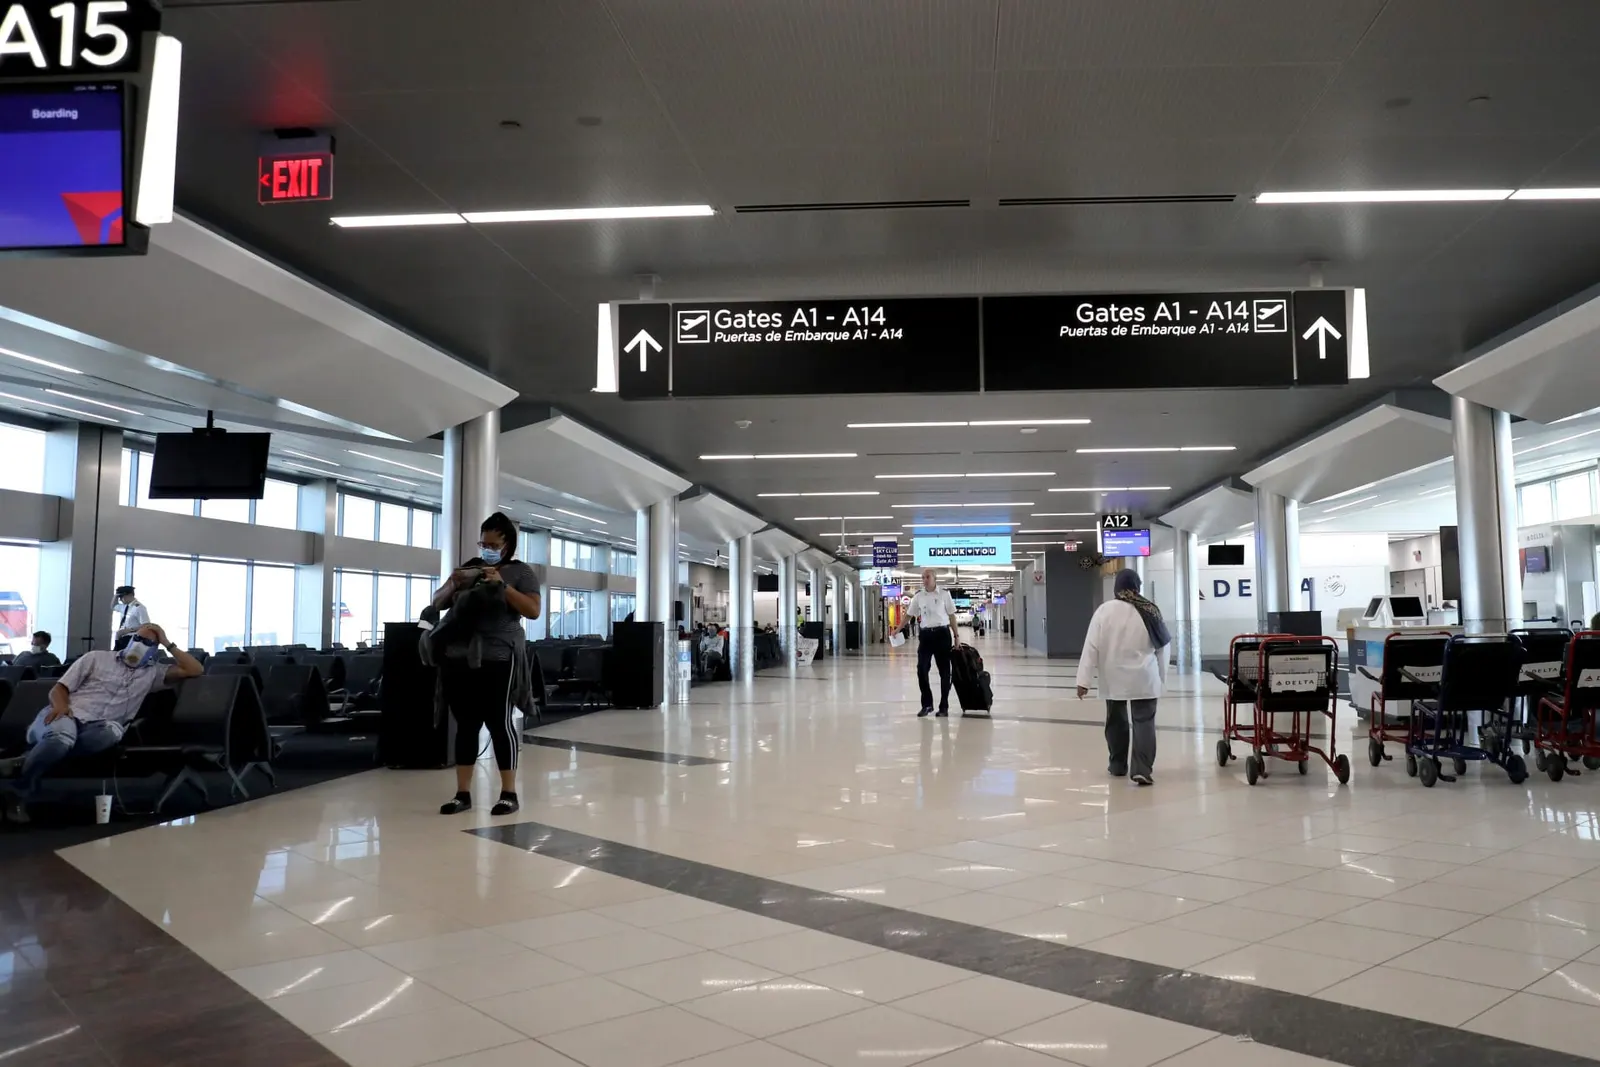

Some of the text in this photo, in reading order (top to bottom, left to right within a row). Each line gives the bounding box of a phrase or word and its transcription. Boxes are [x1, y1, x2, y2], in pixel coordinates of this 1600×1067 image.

[0, 1, 128, 67] A15
[32, 108, 78, 119] Boarding
[272, 158, 323, 198] EXIT
[714, 309, 782, 329] Gates
[790, 308, 817, 327] A1
[842, 306, 886, 326] A14
[1076, 303, 1146, 323] Gates
[1153, 301, 1180, 321] A1
[1205, 300, 1249, 320] A14
[714, 331, 762, 342] Puertas
[765, 331, 782, 342] de
[785, 329, 849, 342] Embarque
[853, 329, 868, 340] A1
[879, 328, 903, 339] A14
[1059, 325, 1108, 337] Puertas
[1111, 325, 1128, 336] de
[1131, 323, 1196, 336] Embarque
[1199, 323, 1215, 334] A1
[1225, 322, 1249, 333] A14
[1103, 515, 1129, 527] A12
[929, 547, 996, 556] THANK YOU
[1213, 577, 1313, 597] DEA
